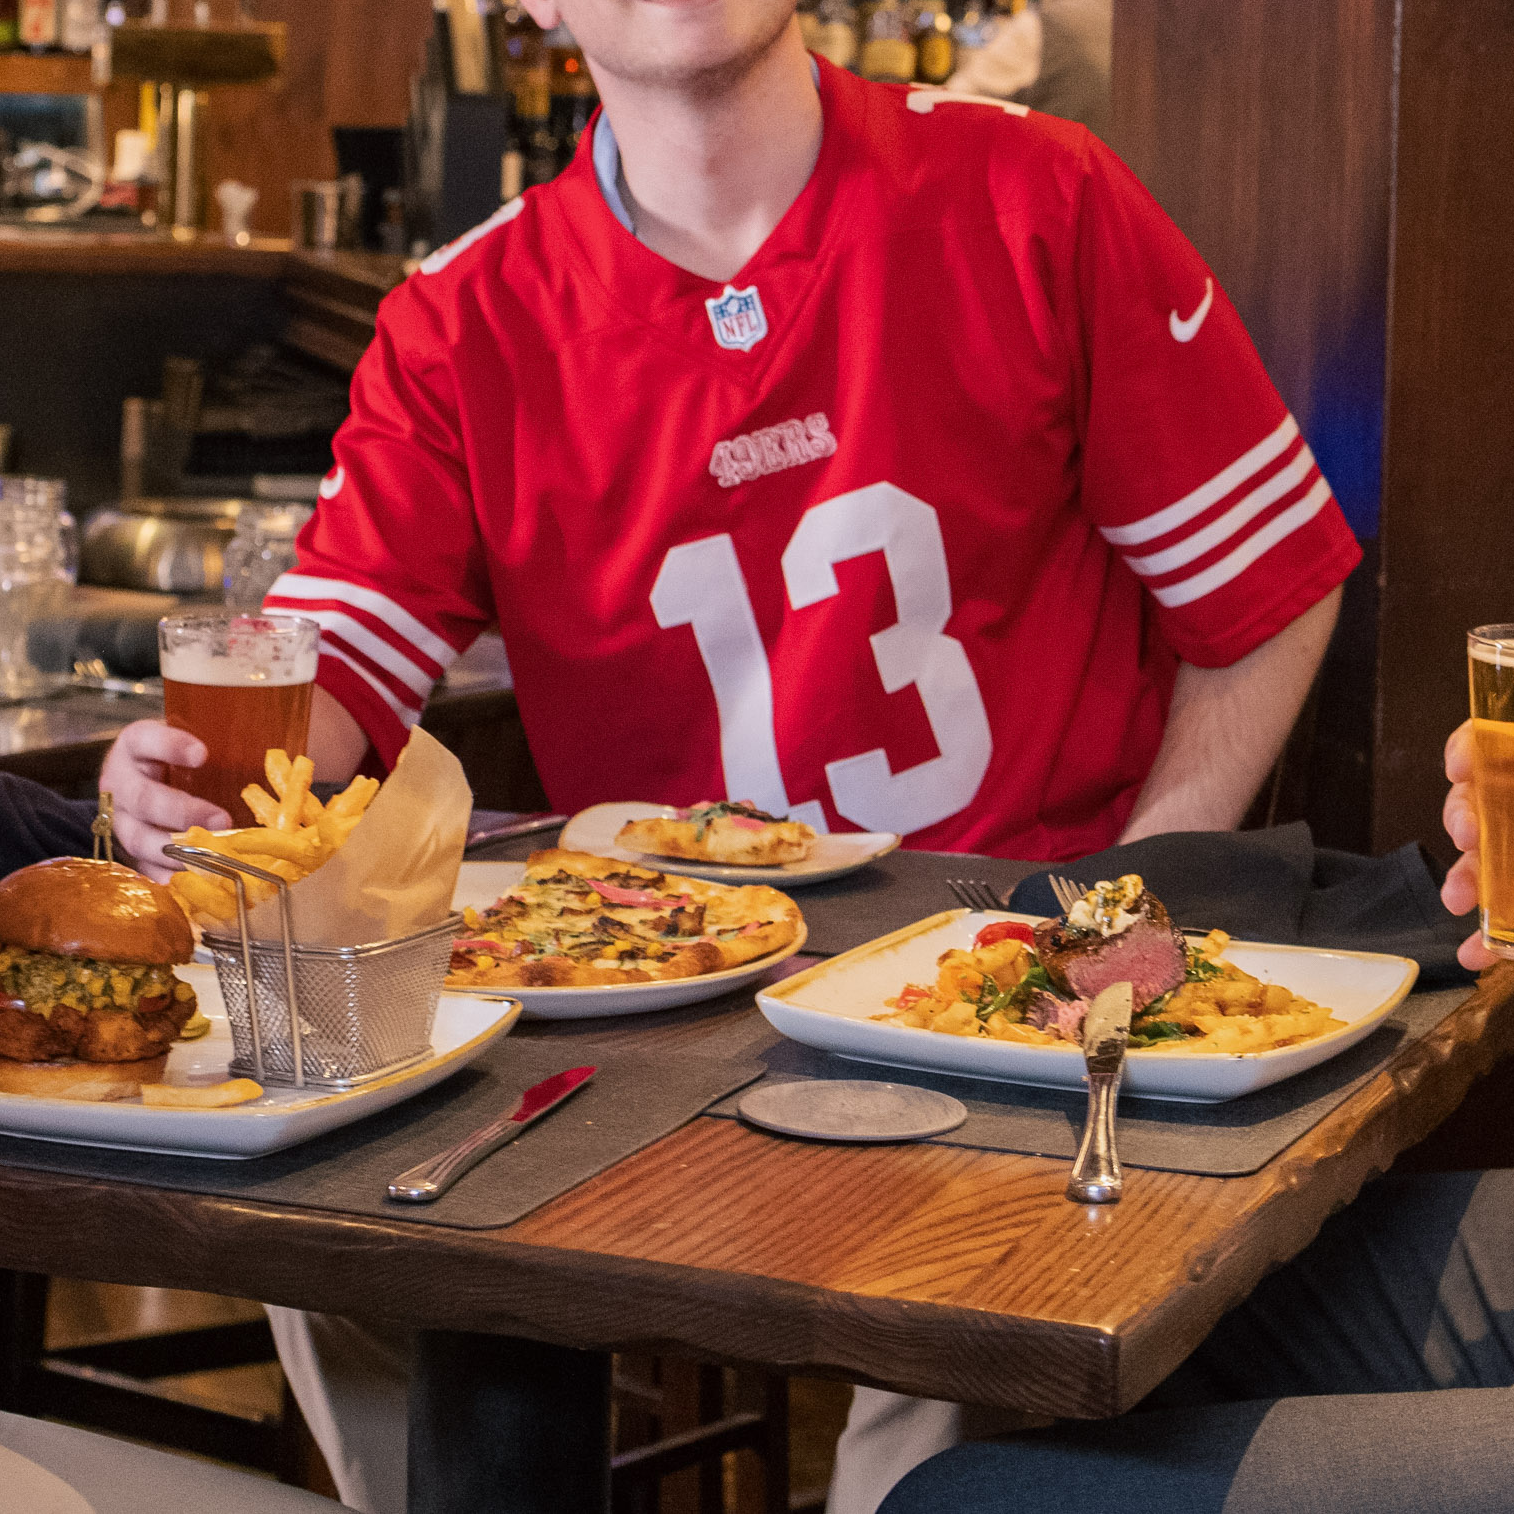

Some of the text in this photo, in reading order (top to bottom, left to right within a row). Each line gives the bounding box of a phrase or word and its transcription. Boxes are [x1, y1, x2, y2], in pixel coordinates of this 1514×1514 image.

[720, 311, 758, 340] NFL
[709, 411, 838, 488] 49ERS
[649, 480, 994, 835] 13
